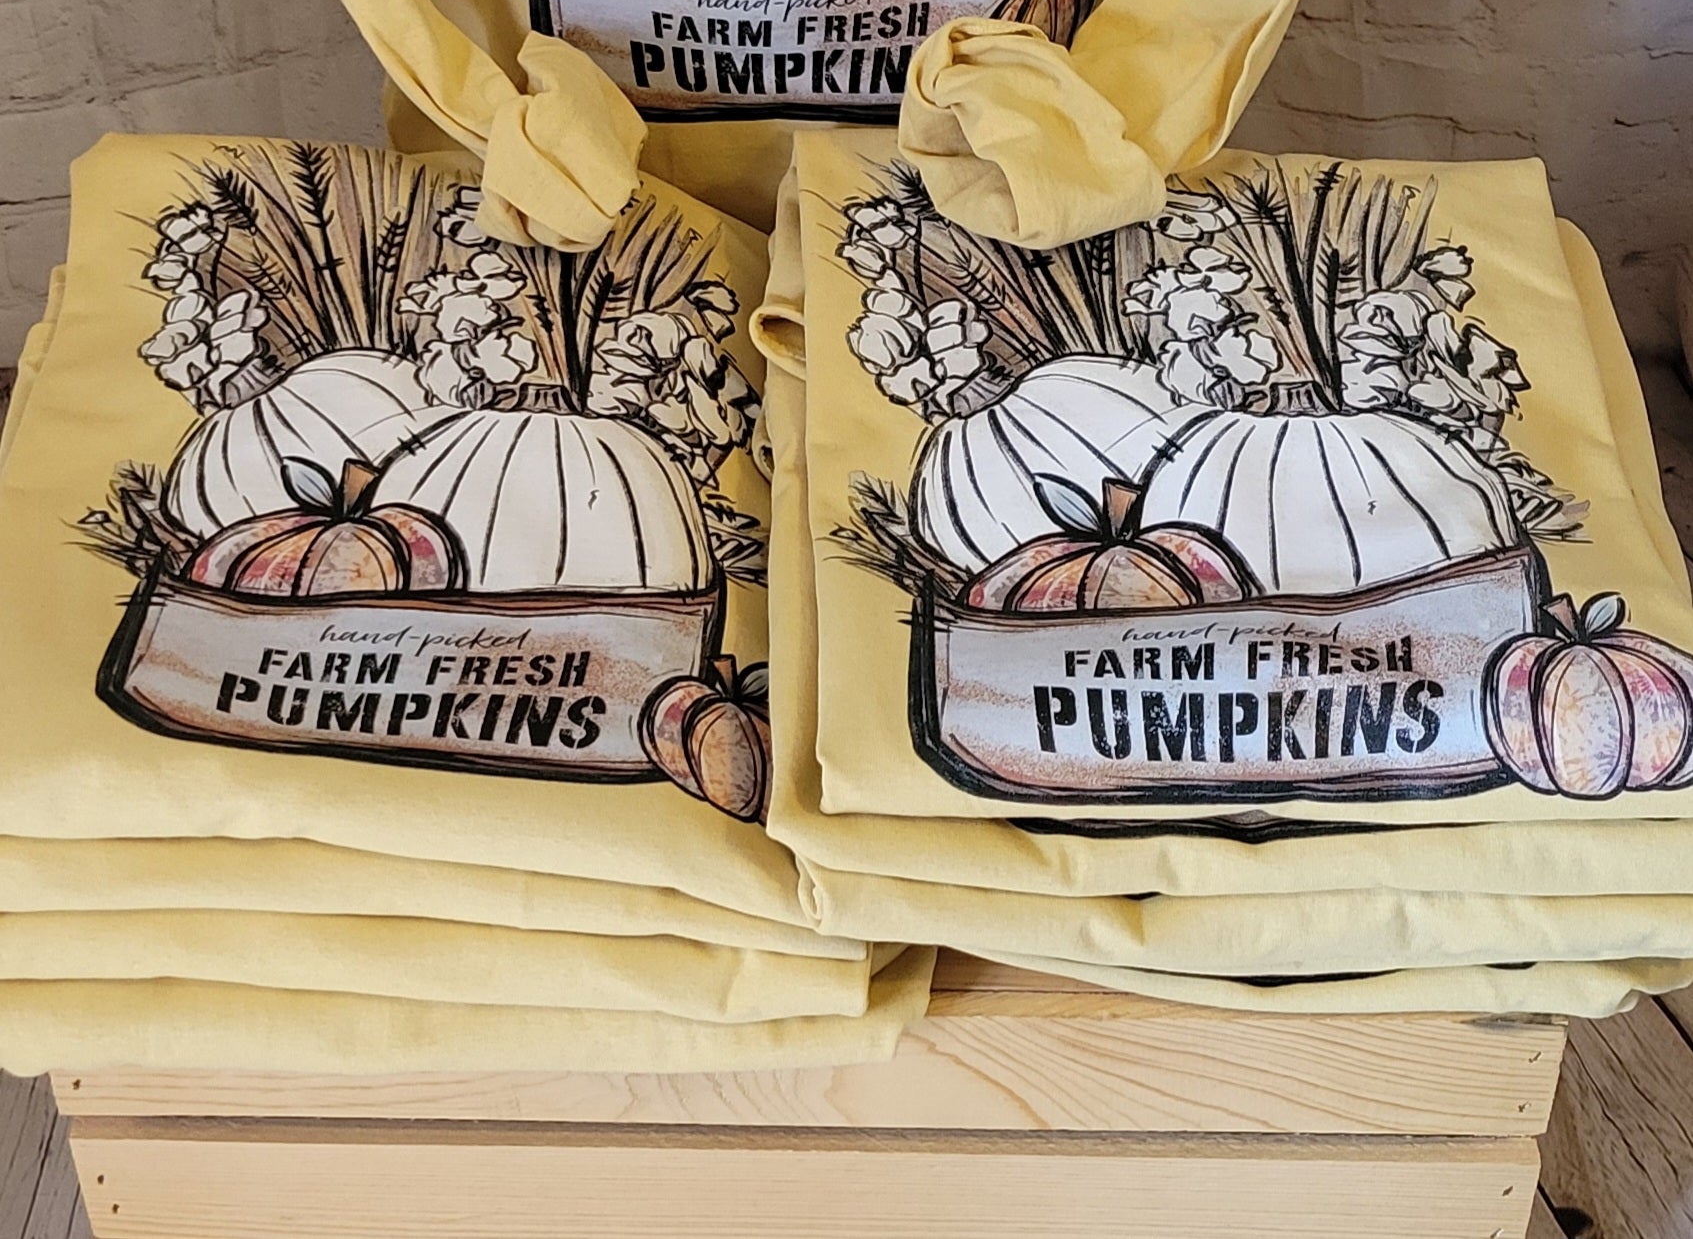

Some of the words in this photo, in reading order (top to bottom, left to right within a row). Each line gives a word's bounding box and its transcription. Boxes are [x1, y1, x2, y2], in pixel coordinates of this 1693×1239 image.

[651, 10, 773, 48] FARM
[798, 1, 931, 45] FRESH
[629, 39, 913, 95] PUMPKIN
[319, 624, 531, 657] hand-picked
[1063, 642, 1216, 681] FARM
[1246, 635, 1413, 680] FRESH
[257, 647, 403, 685] FARM
[425, 650, 592, 688] FRESH
[215, 672, 607, 750] PUMPKINS
[1032, 679, 1445, 763] PUMPKINS
